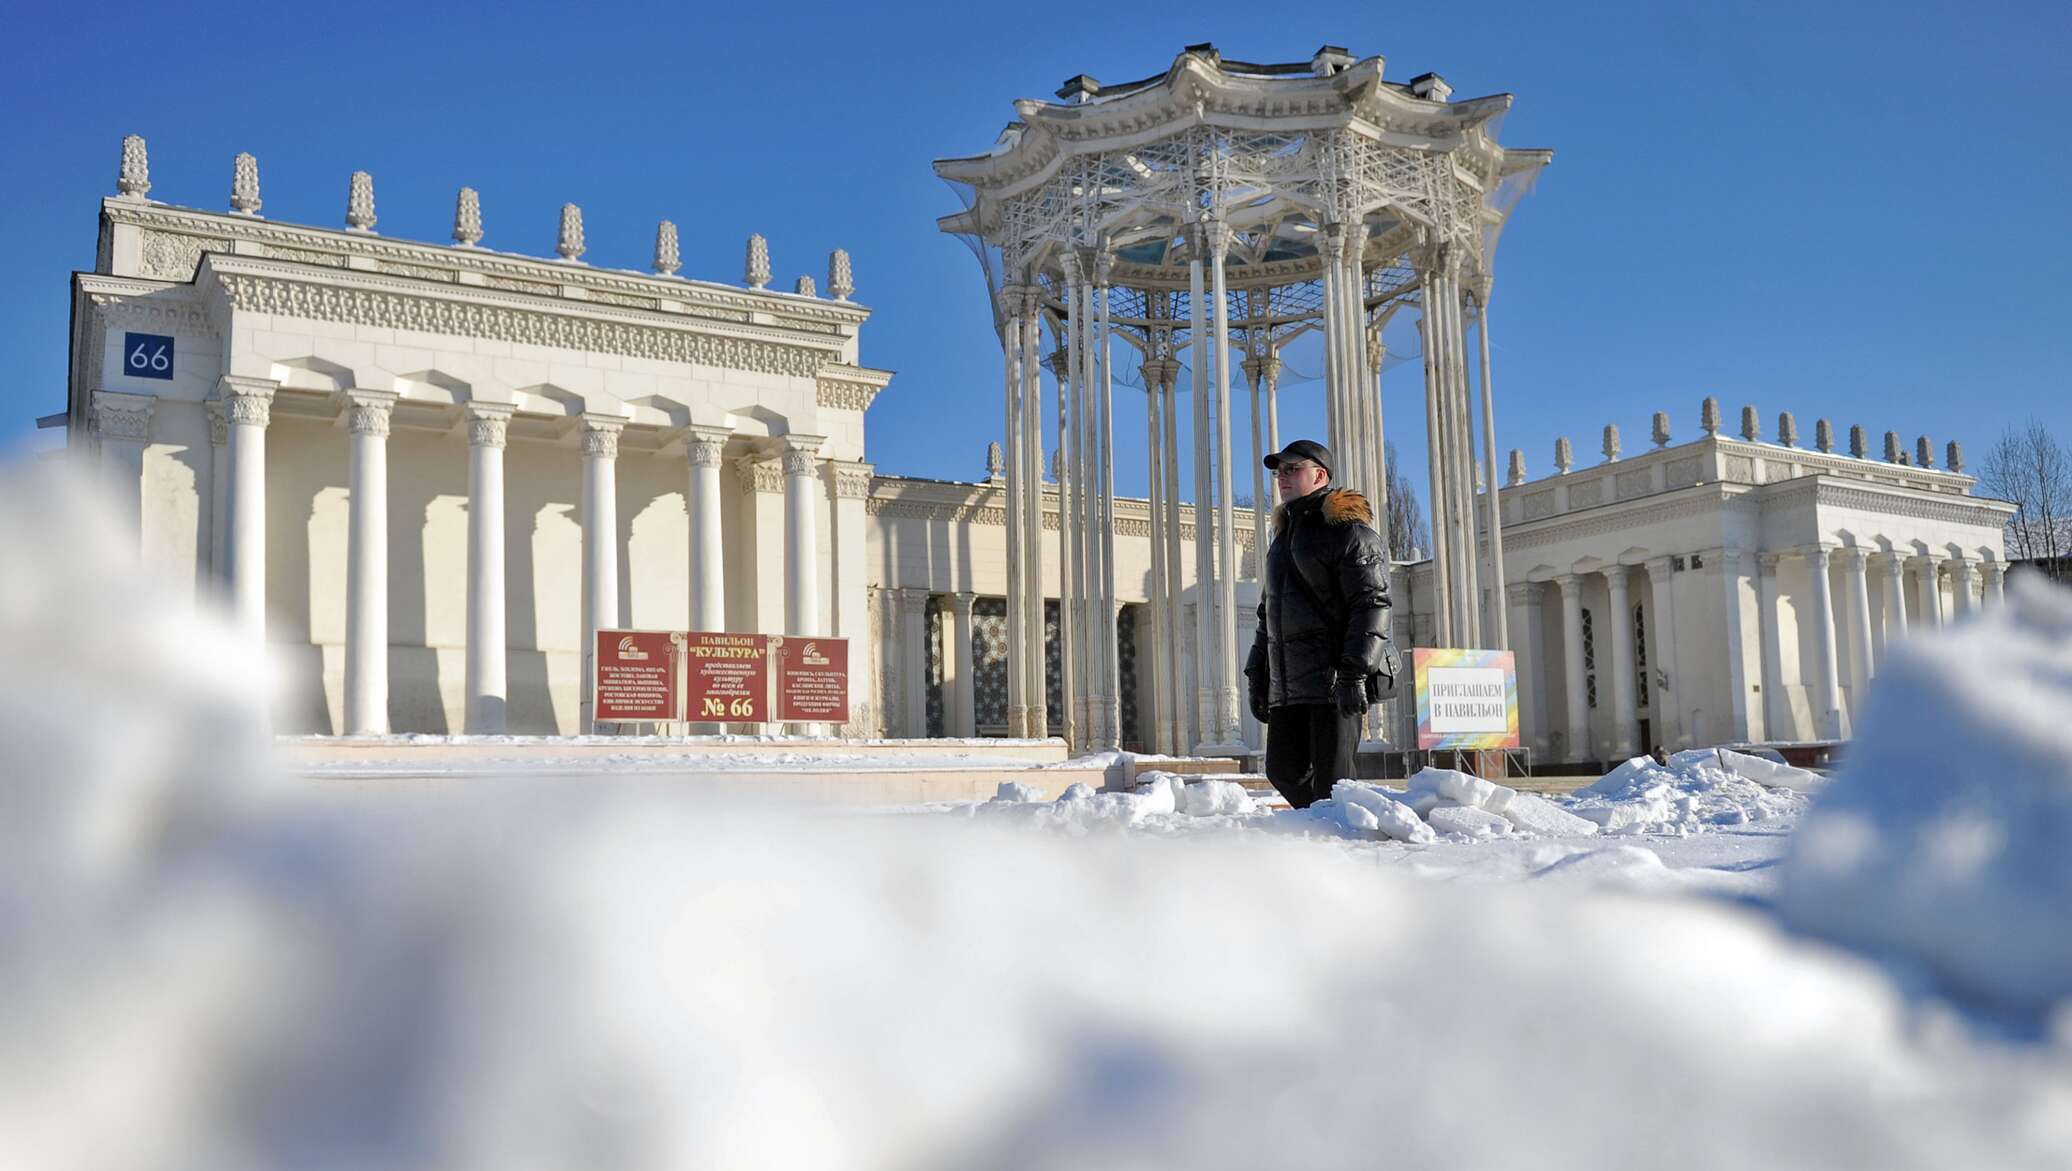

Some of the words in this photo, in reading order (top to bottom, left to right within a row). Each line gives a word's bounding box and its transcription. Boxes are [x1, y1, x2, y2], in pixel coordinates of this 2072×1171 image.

[130, 343, 169, 371] 66
[701, 636, 754, 646] ПАВИЛЬОН
[1432, 683, 1502, 697] ПРИГЛАШАЕМ
[701, 698, 725, 717] №
[730, 698, 753, 717] 66
[1434, 703, 1441, 717] В
[1445, 703, 1503, 718] ПАВИЛЬОН
